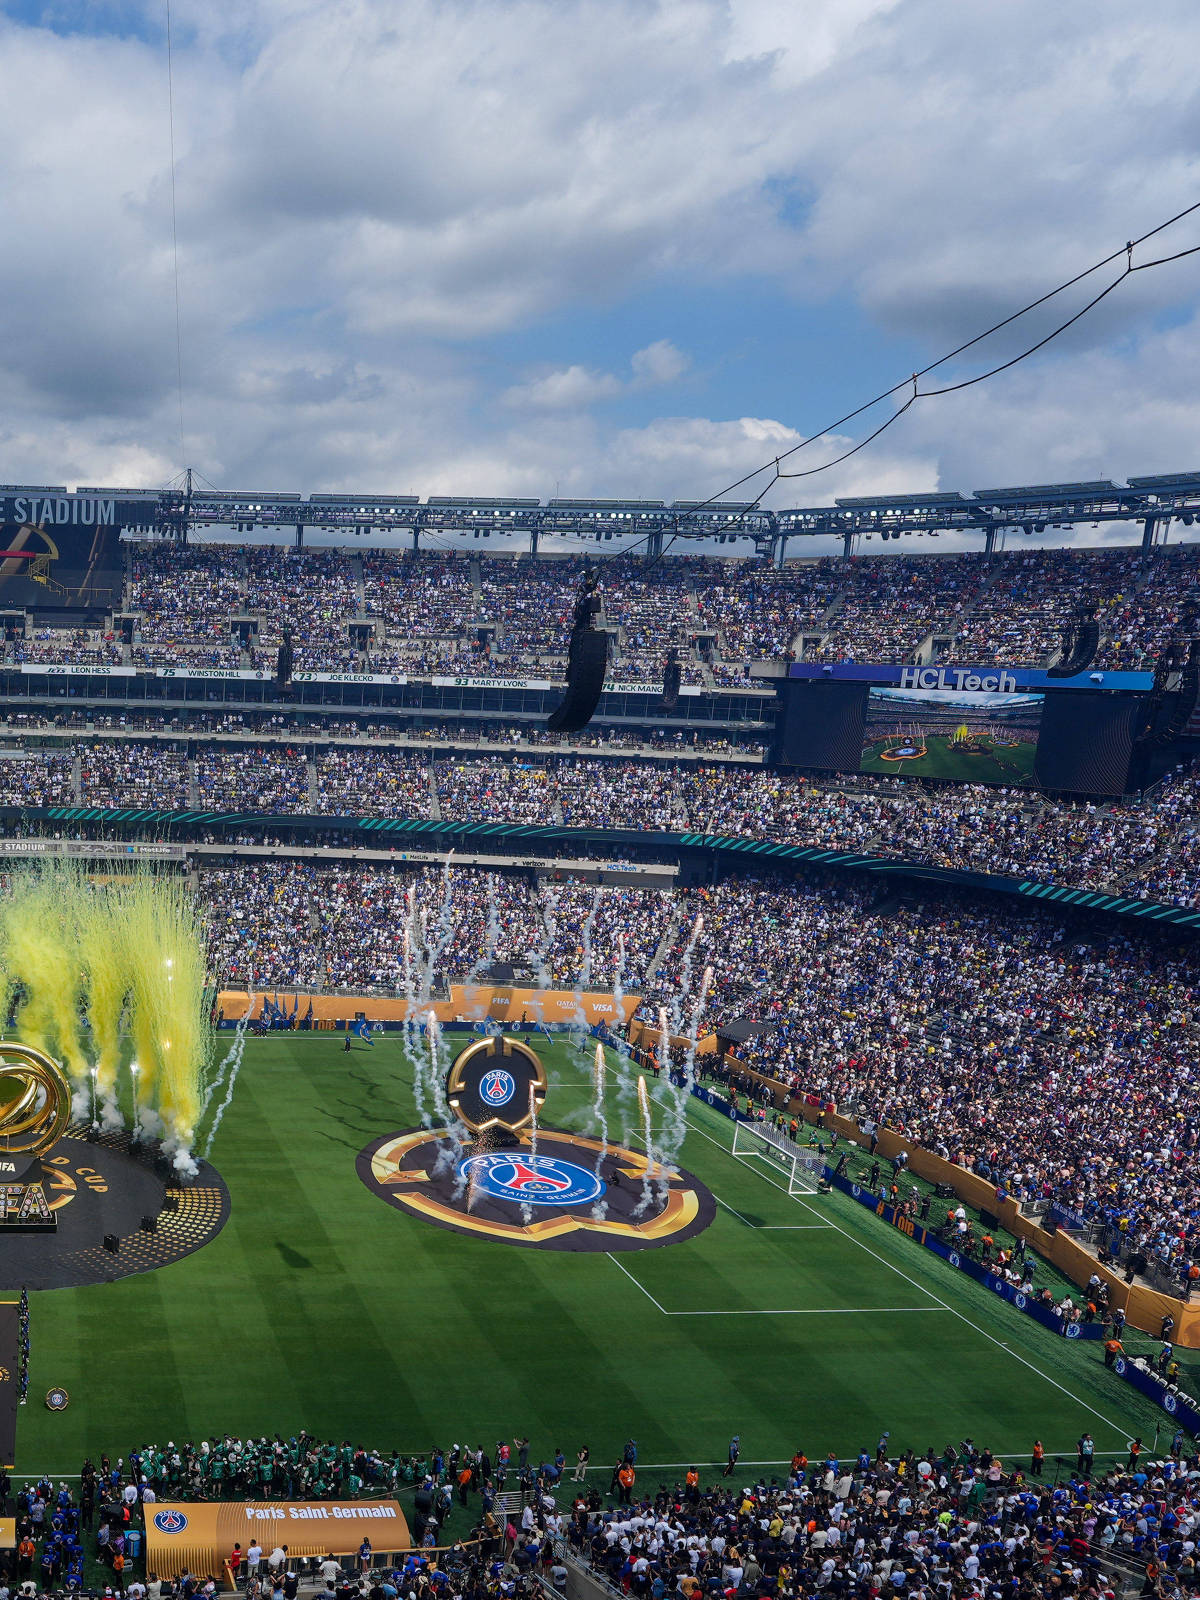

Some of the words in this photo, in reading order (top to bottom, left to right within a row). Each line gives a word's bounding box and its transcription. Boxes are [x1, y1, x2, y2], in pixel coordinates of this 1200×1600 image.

[14, 498, 114, 525] STADIUM
[901, 668, 1016, 692] HCLTech
[492, 997, 510, 1005] FIFA
[592, 1003, 612, 1012] VISA
[486, 1072, 509, 1080] PARIS
[473, 1155, 557, 1168] PARIS
[75, 1167, 109, 1192] CUP
[246, 1507, 285, 1519] Paris
[289, 1506, 396, 1519] Saint-Germain
